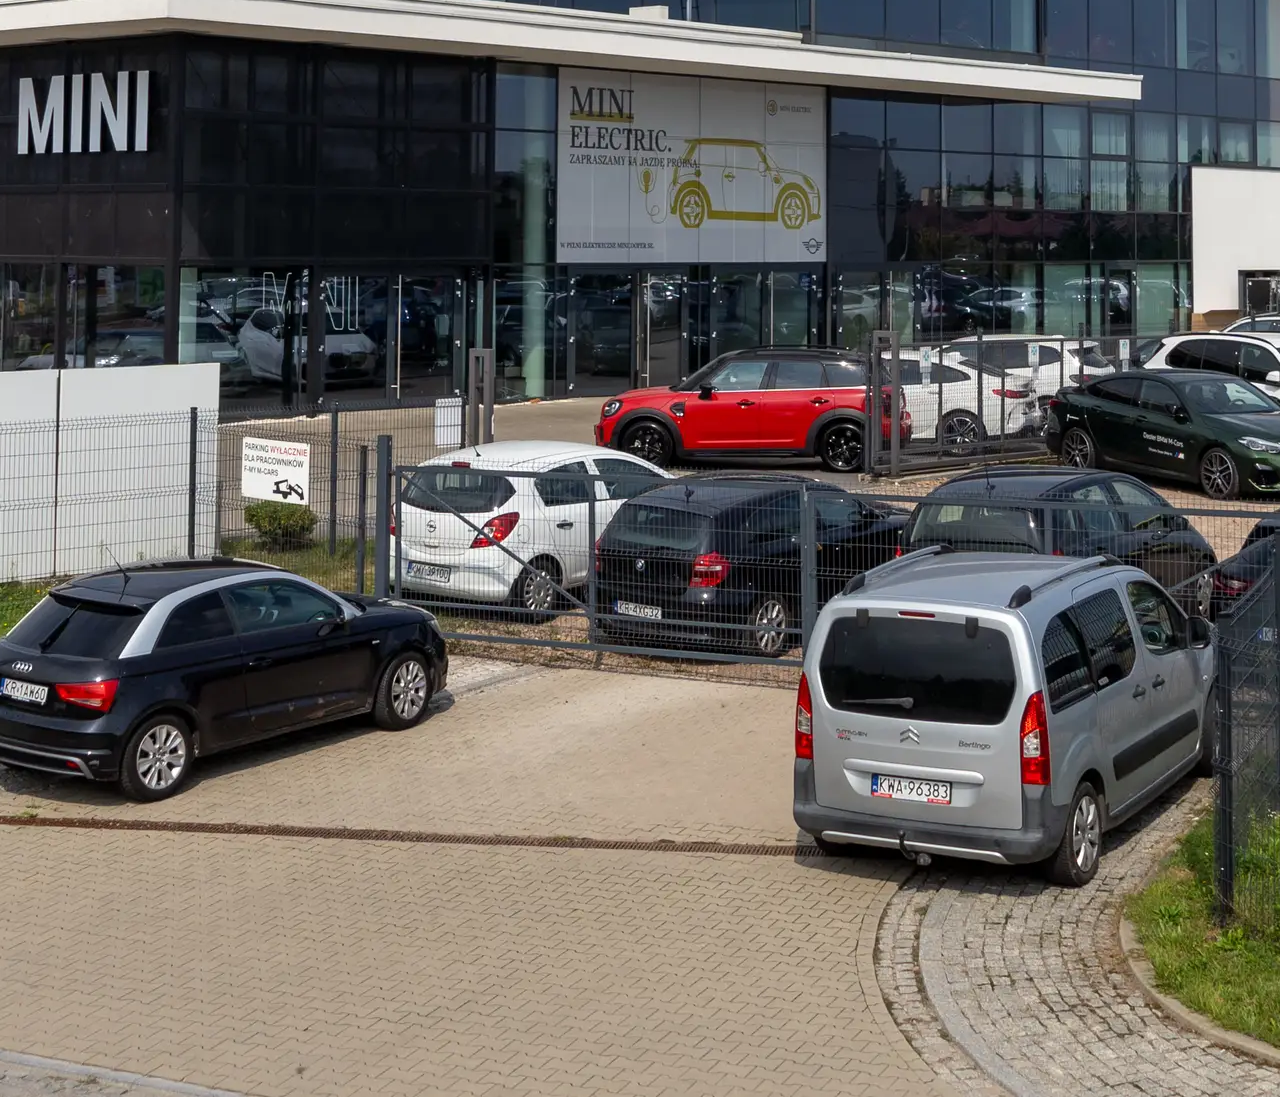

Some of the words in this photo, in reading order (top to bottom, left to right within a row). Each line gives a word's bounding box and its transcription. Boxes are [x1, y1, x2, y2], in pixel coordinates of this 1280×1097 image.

[570, 85, 635, 120] MINI
[18, 70, 150, 155] MINI
[570, 125, 672, 153] ELECTRIC.
[569, 154, 626, 166] ZAPRASZAMY
[244, 442, 269, 453] PARKING
[270, 446, 308, 457] WYŁĄCZNIE
[244, 454, 255, 462] DLA
[255, 455, 304, 468] PRACOWNIKÓW
[619, 602, 630, 613] KR
[632, 604, 660, 618] 4XG32
[4, 680, 17, 695] KR
[19, 683, 46, 701] 1AW60
[958, 739, 992, 750] Berlingo
[878, 777, 903, 795] KWA
[907, 780, 949, 799] 96383
